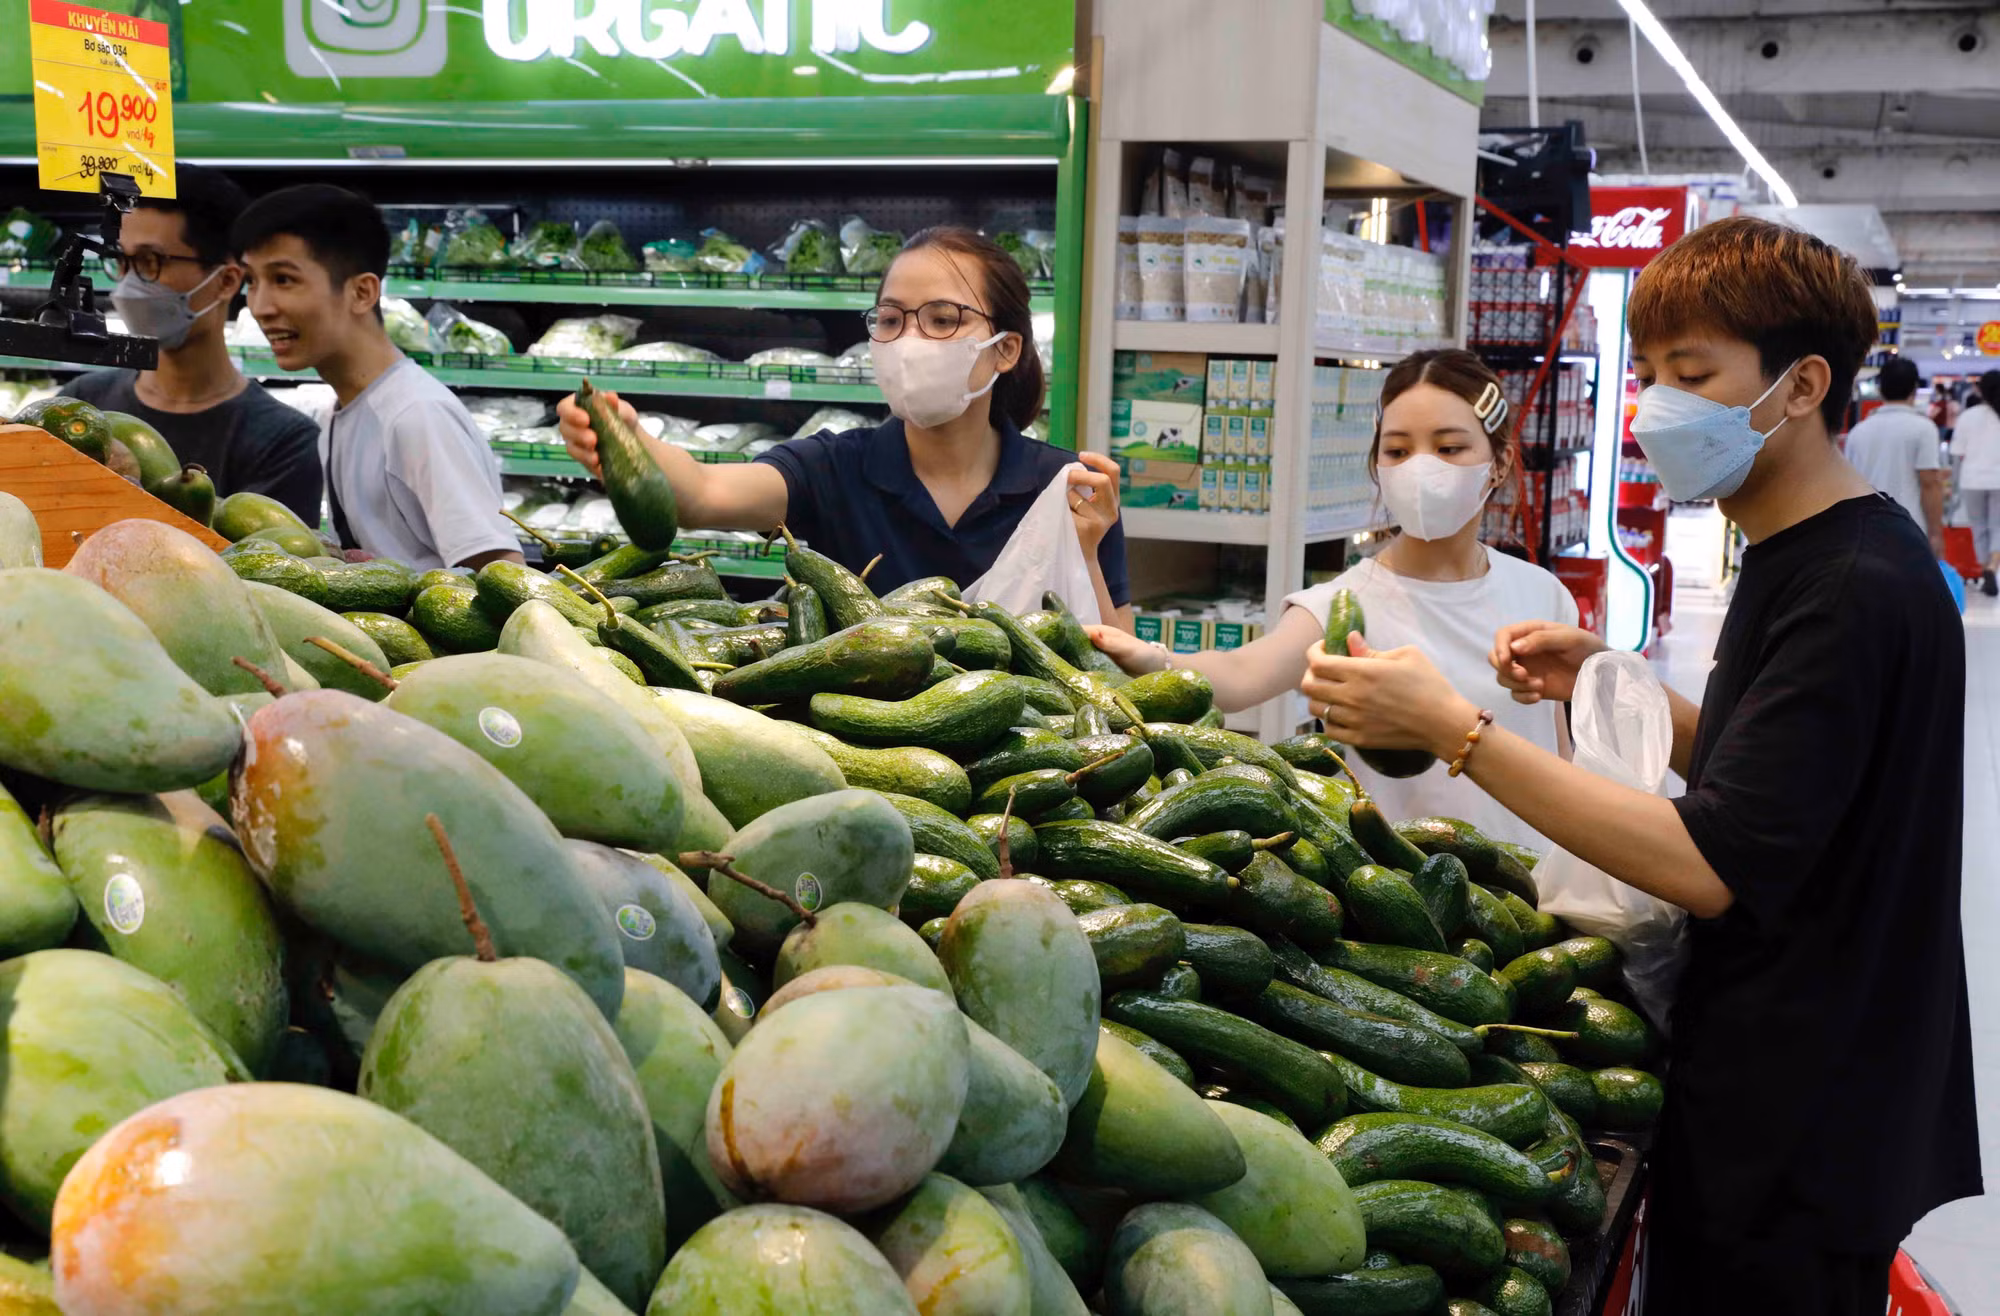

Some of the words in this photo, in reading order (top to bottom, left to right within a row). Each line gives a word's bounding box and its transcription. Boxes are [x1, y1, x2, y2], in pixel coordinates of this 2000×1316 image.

[68, 11, 117, 35] KHUYẾN
[84, 38, 96, 51] Bơ
[112, 44, 127, 57] 034
